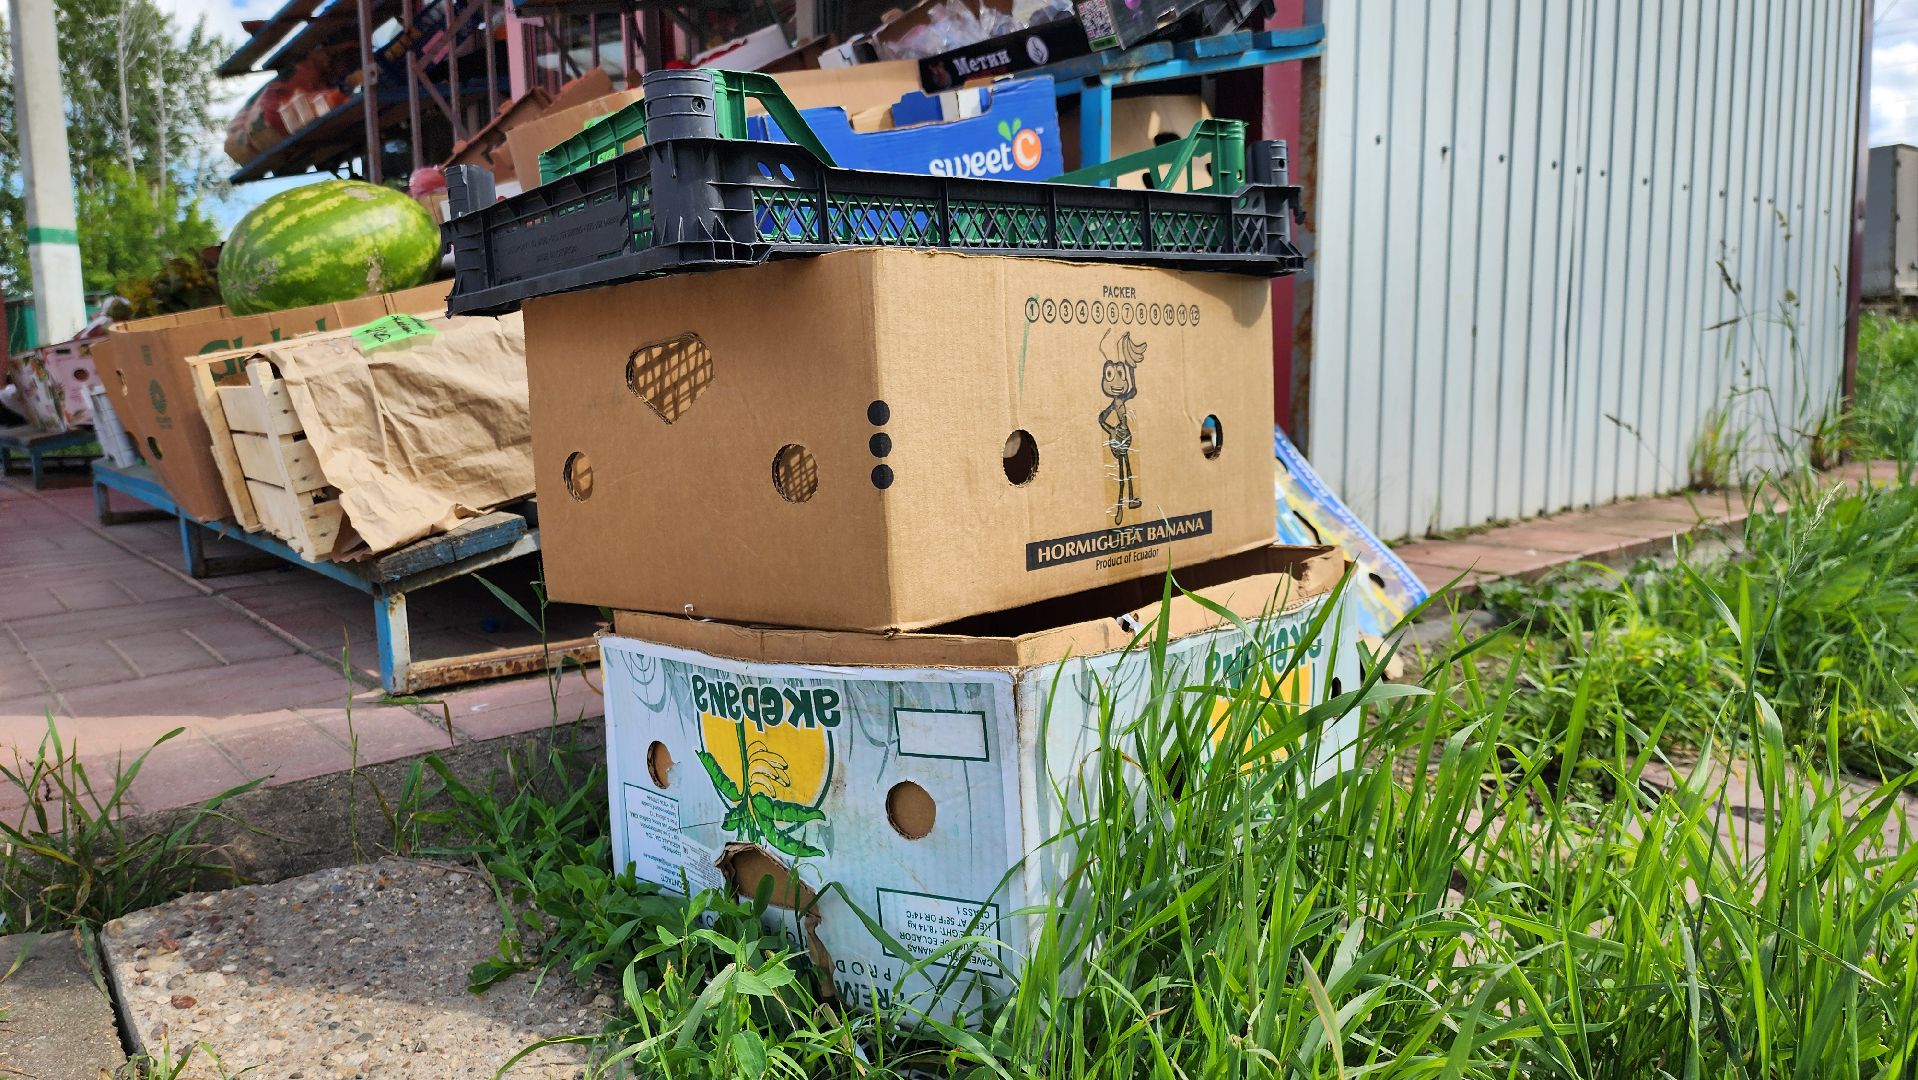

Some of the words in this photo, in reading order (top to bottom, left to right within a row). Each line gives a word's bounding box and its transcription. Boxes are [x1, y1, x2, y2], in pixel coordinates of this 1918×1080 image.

[1102, 285, 1137, 300] PACKER
[1037, 531, 1143, 563] HORMIGUITA
[1147, 517, 1205, 541] BANANA
[1096, 554, 1122, 571] Product
[1124, 552, 1132, 564] of
[1133, 548, 1159, 563] Ecuador
[924, 914, 937, 922] OR
[963, 907, 990, 918] CASS
[907, 920, 917, 930] kg
[957, 919, 967, 927] AT
[918, 924, 938, 934] 18.14
[939, 927, 965, 939] EIGHT:
[899, 931, 938, 946] ECUADOR
